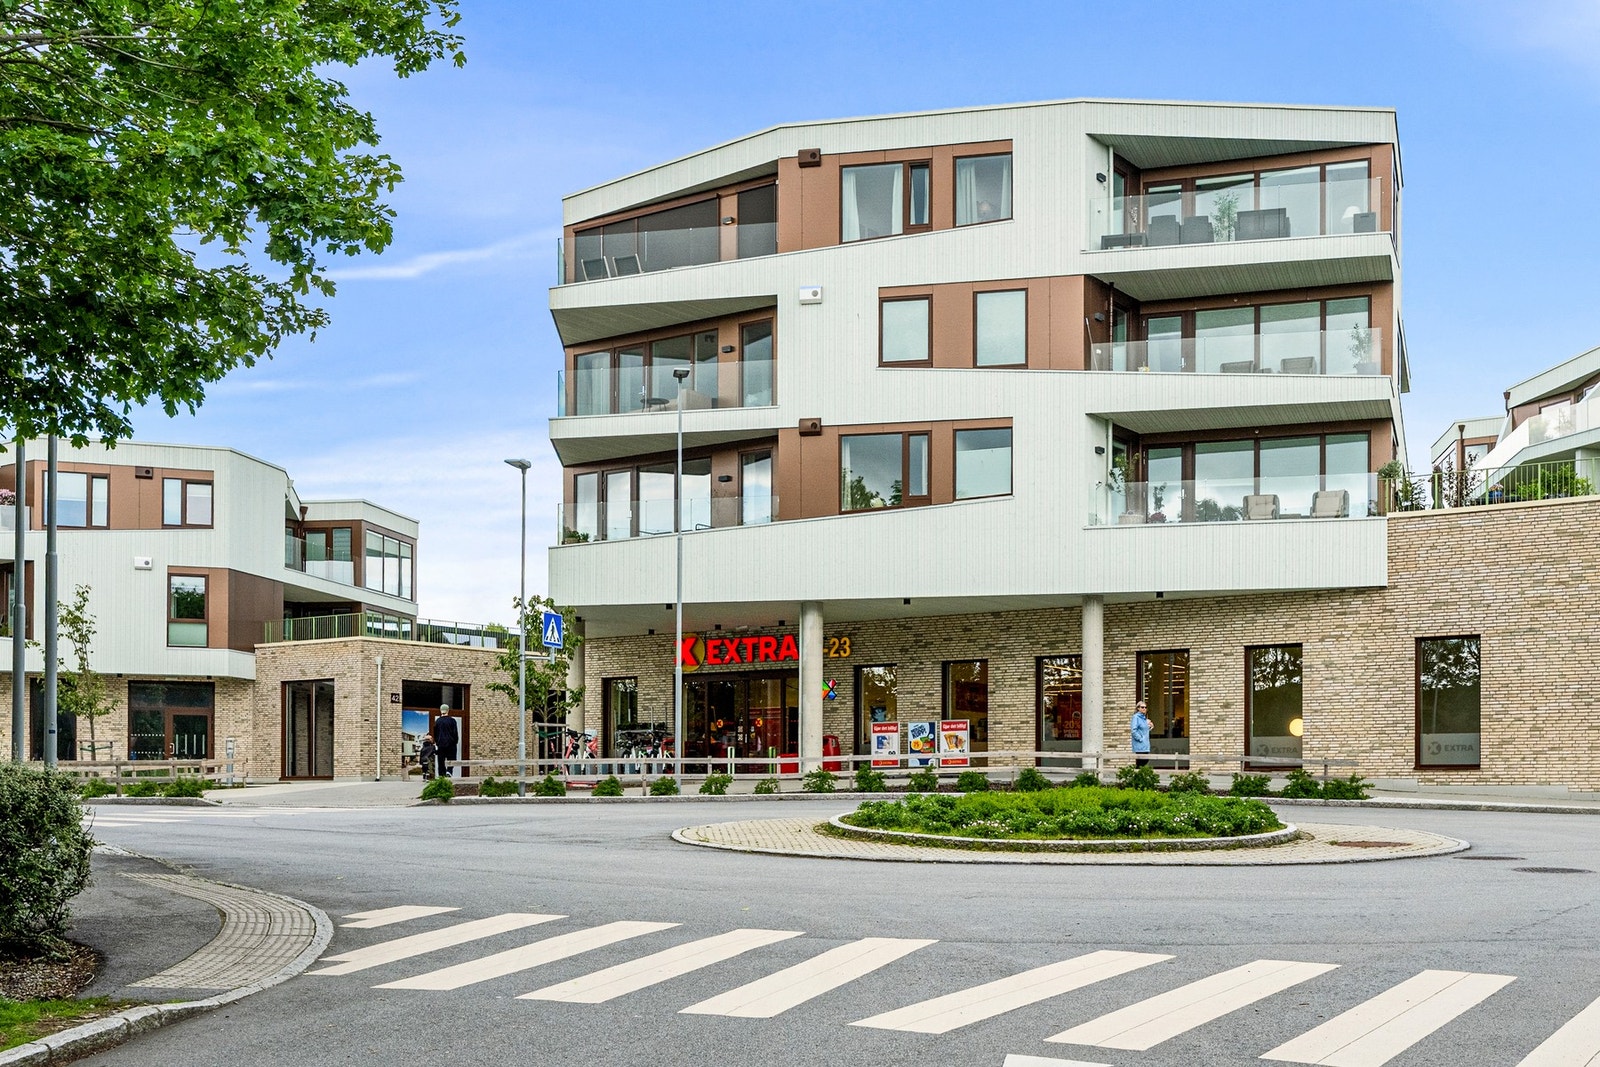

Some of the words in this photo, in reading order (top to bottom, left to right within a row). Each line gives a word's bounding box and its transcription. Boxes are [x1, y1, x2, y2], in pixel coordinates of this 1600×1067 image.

[707, 634, 799, 665] EXTRA
[1271, 746, 1299, 754] EXTRA
[1444, 744, 1474, 752] EXTRA
